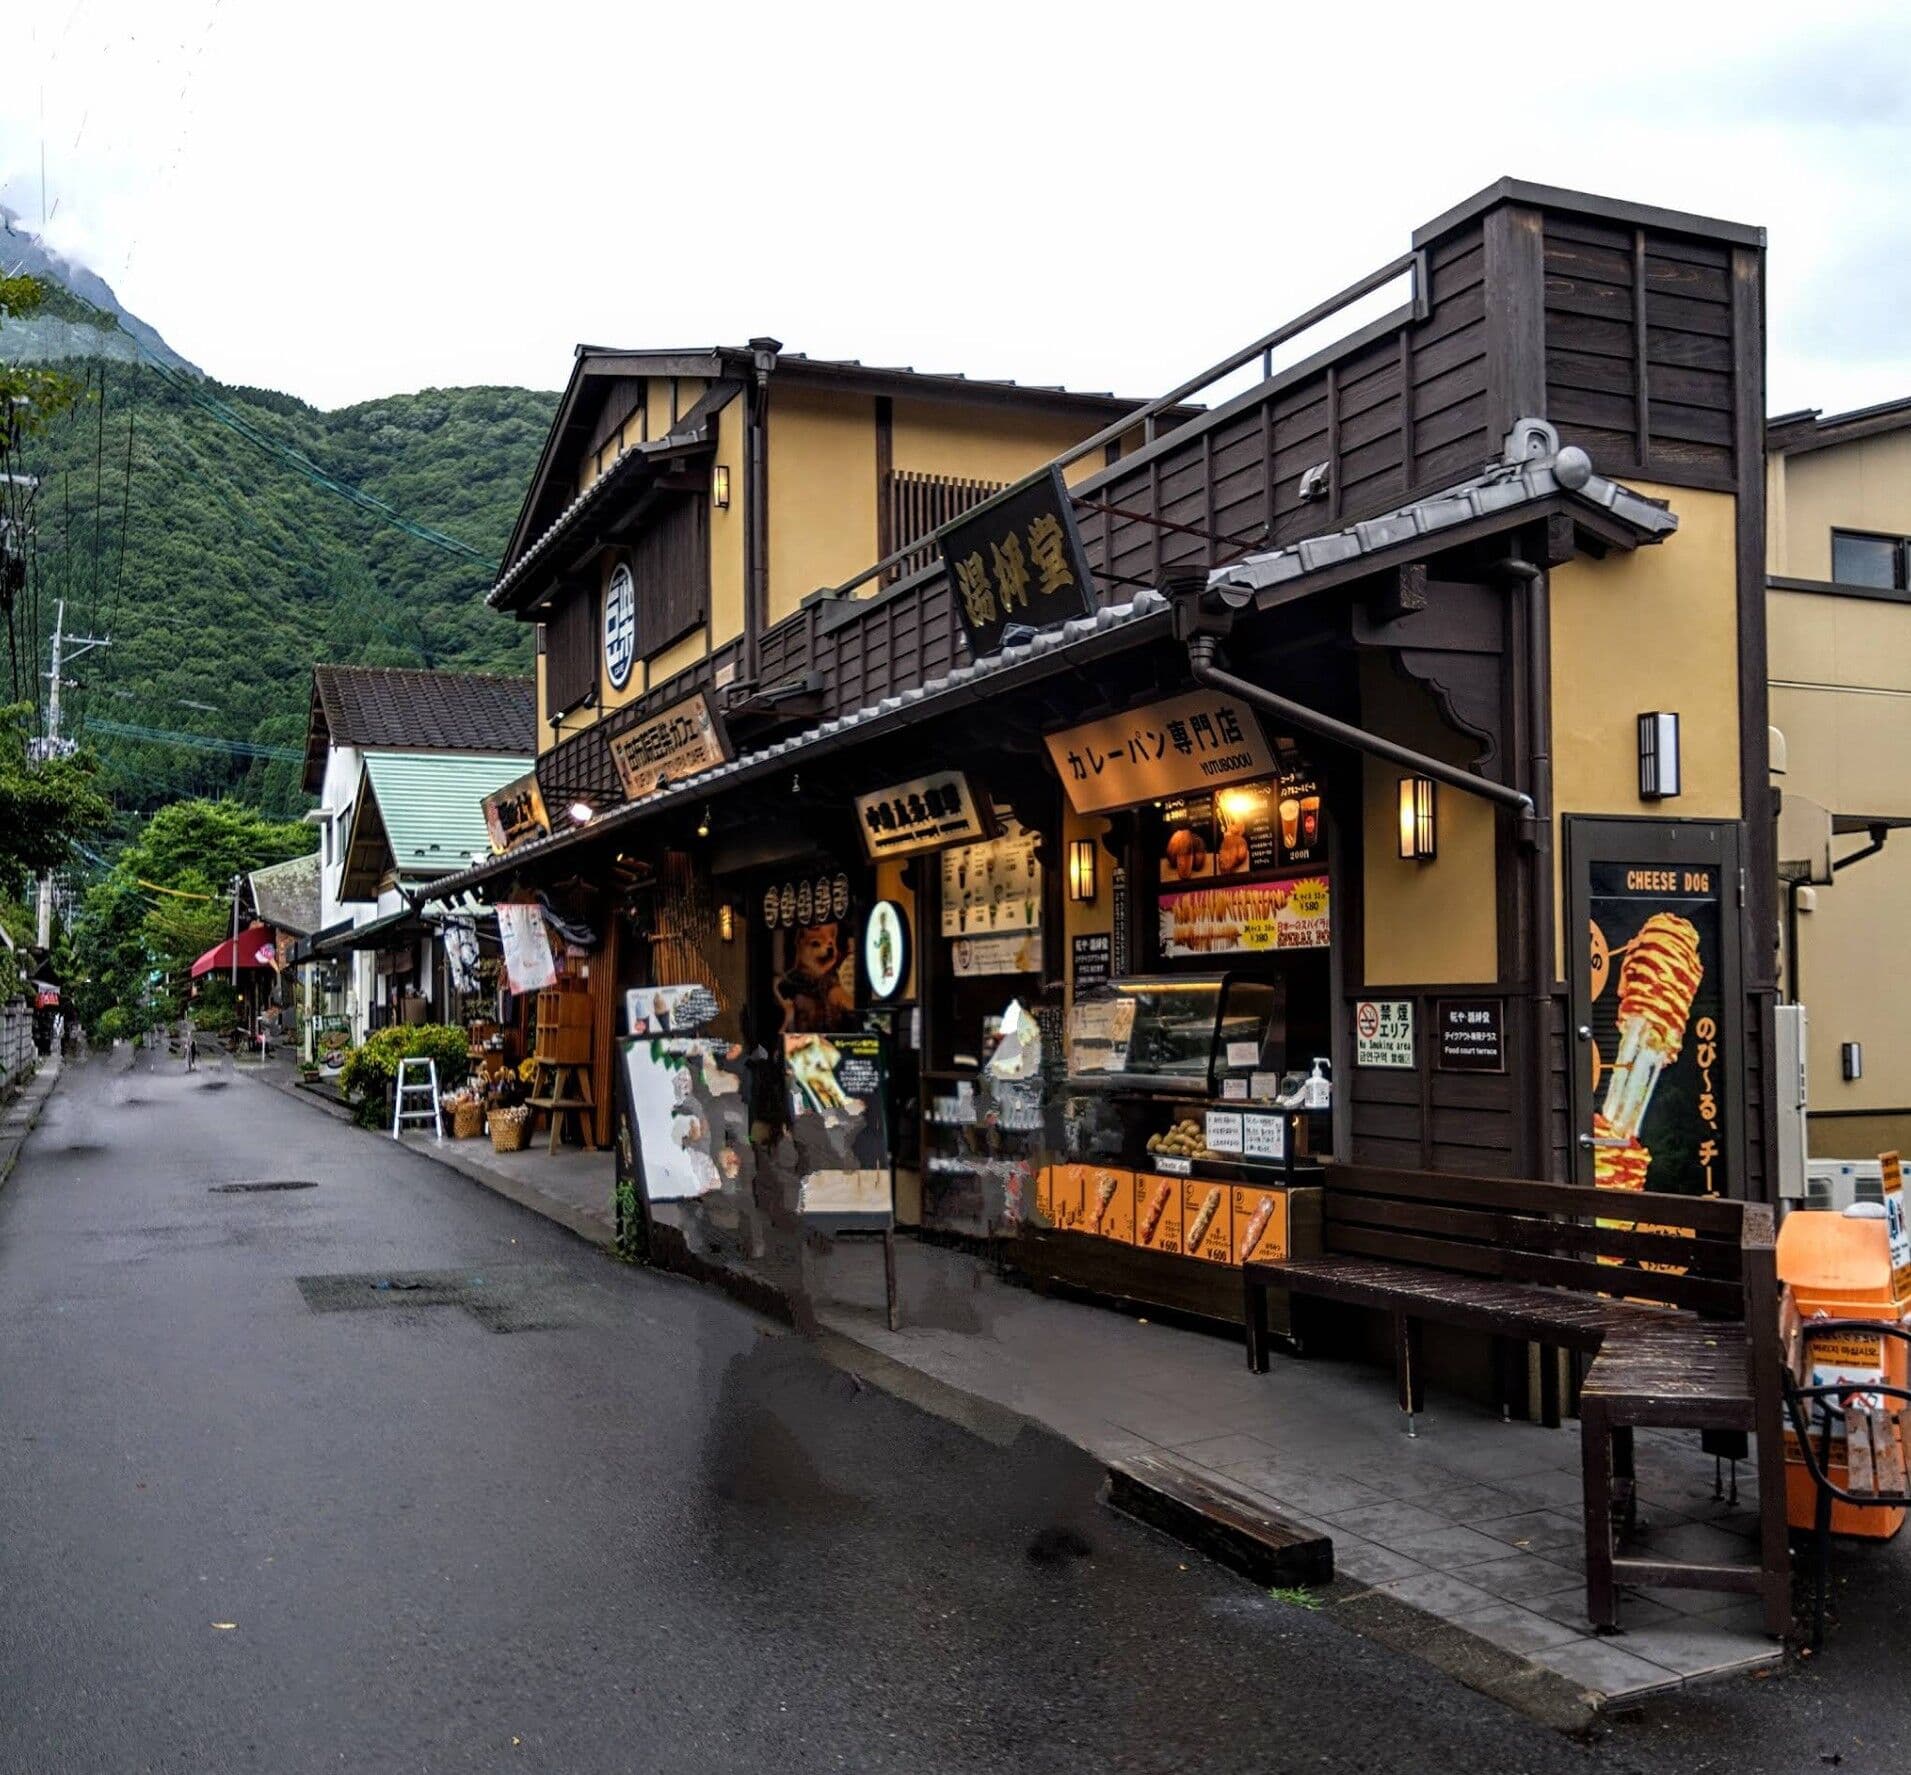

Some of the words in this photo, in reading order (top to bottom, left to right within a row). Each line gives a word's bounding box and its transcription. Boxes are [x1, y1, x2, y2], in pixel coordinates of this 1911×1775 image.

[1067, 705, 1245, 780] カレーパン専門店
[1627, 870, 1677, 891] CHEESE
[1684, 872, 1709, 892] DOG
[1380, 1003, 1408, 1021] 禁煙
[1379, 1023, 1410, 1039] エリア
[1369, 1040, 1393, 1051] Smoking
[1397, 1042, 1411, 1051] area
[1444, 1046, 1460, 1055] Food
